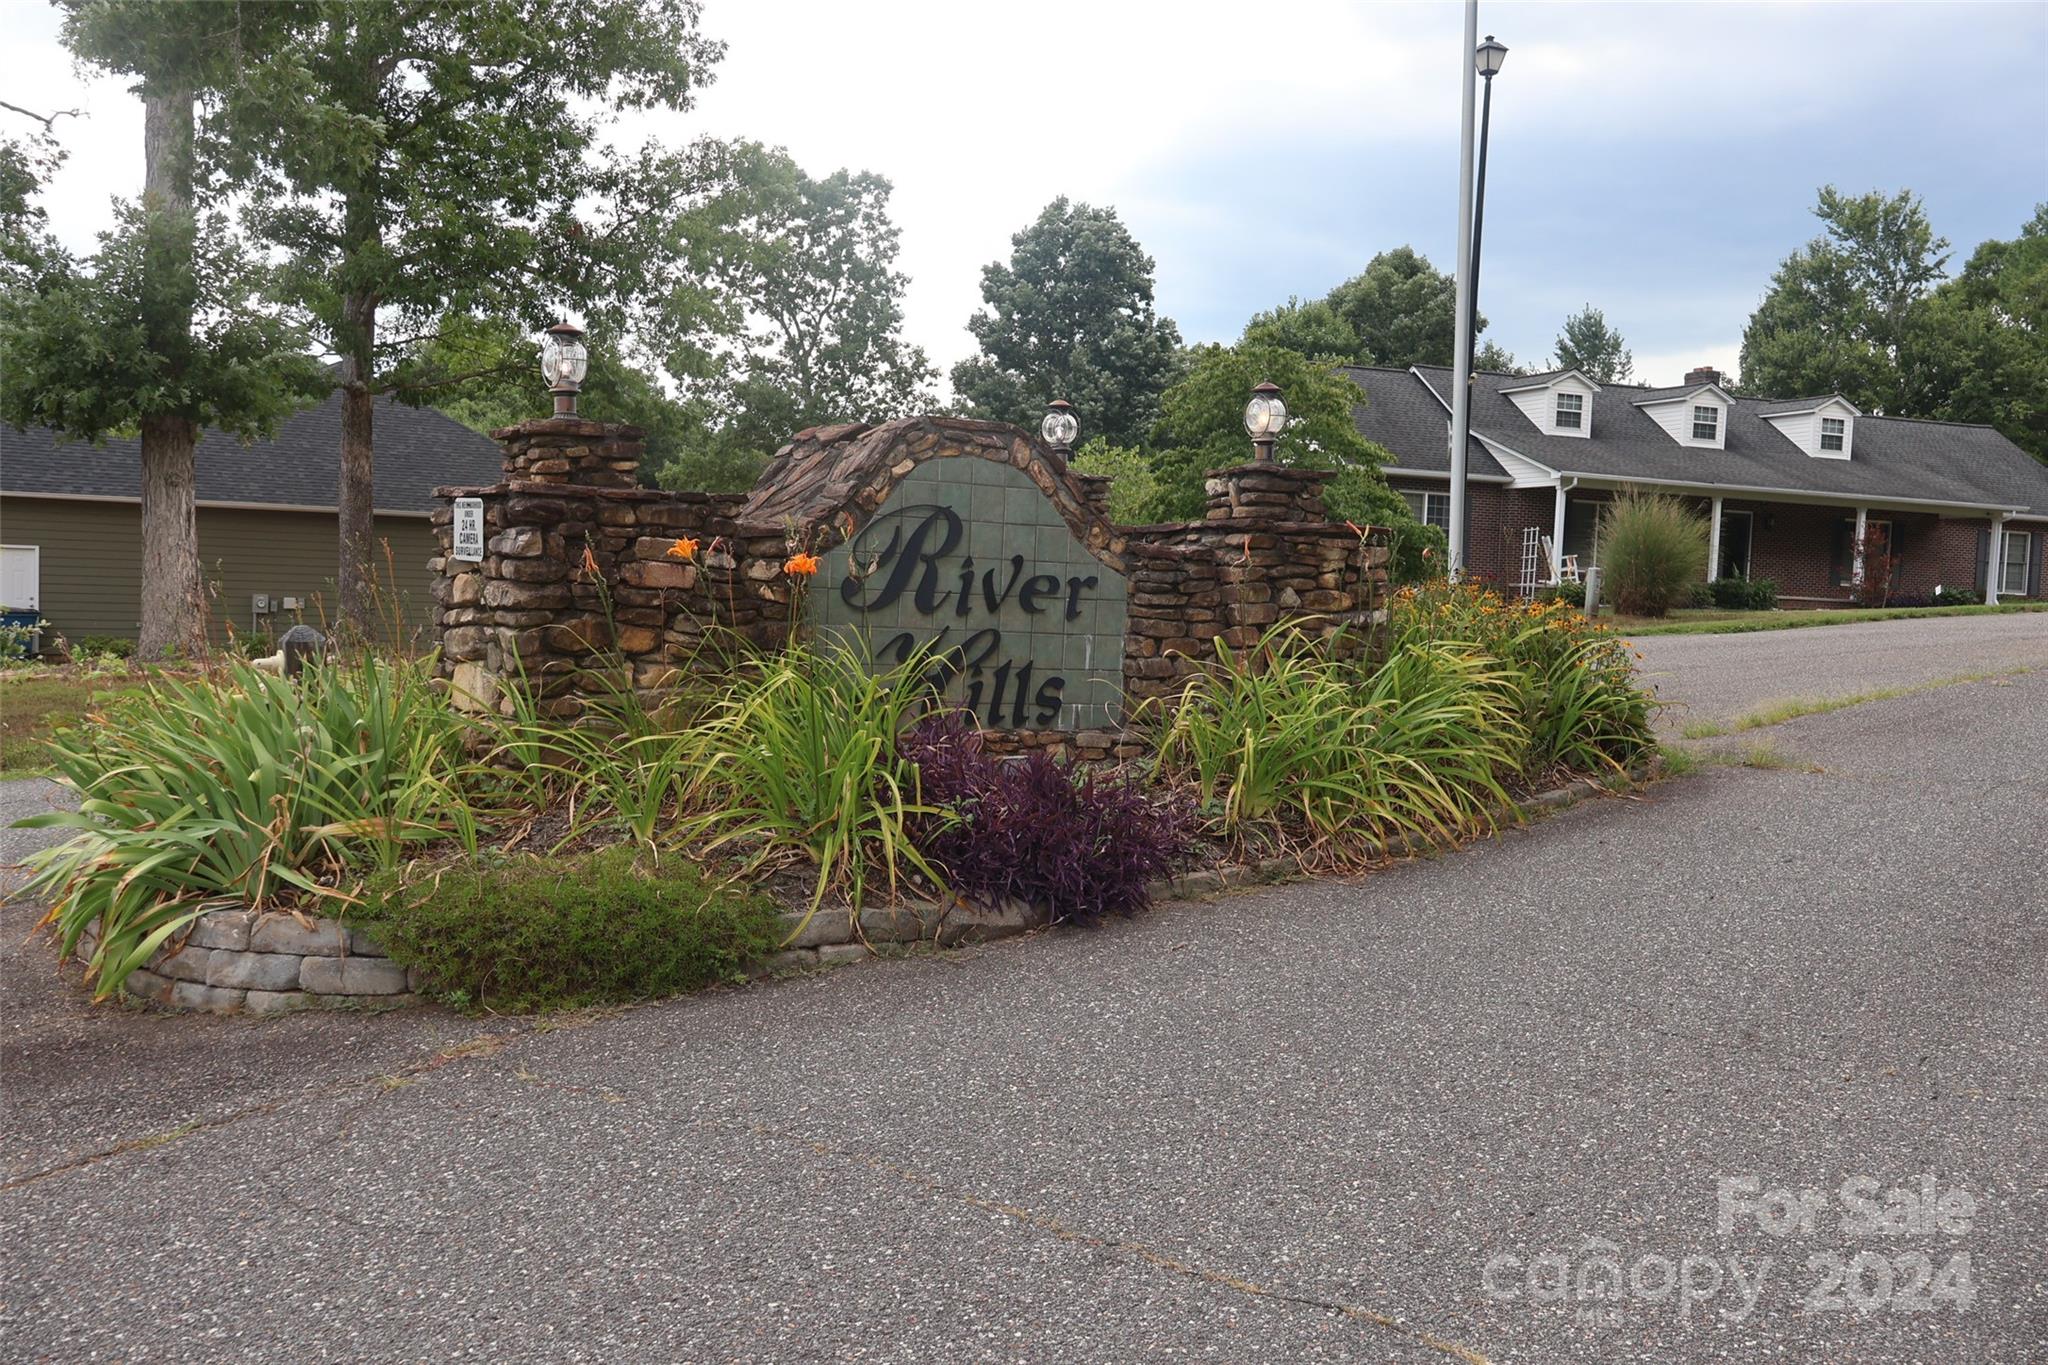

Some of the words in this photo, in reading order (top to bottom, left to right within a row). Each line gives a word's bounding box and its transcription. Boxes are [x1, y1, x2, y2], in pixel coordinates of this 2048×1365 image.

[461, 520, 468, 531] 24
[459, 532, 479, 545] CAMERA
[455, 545, 482, 557] SURVEILLANCE
[840, 503, 1099, 622] River
